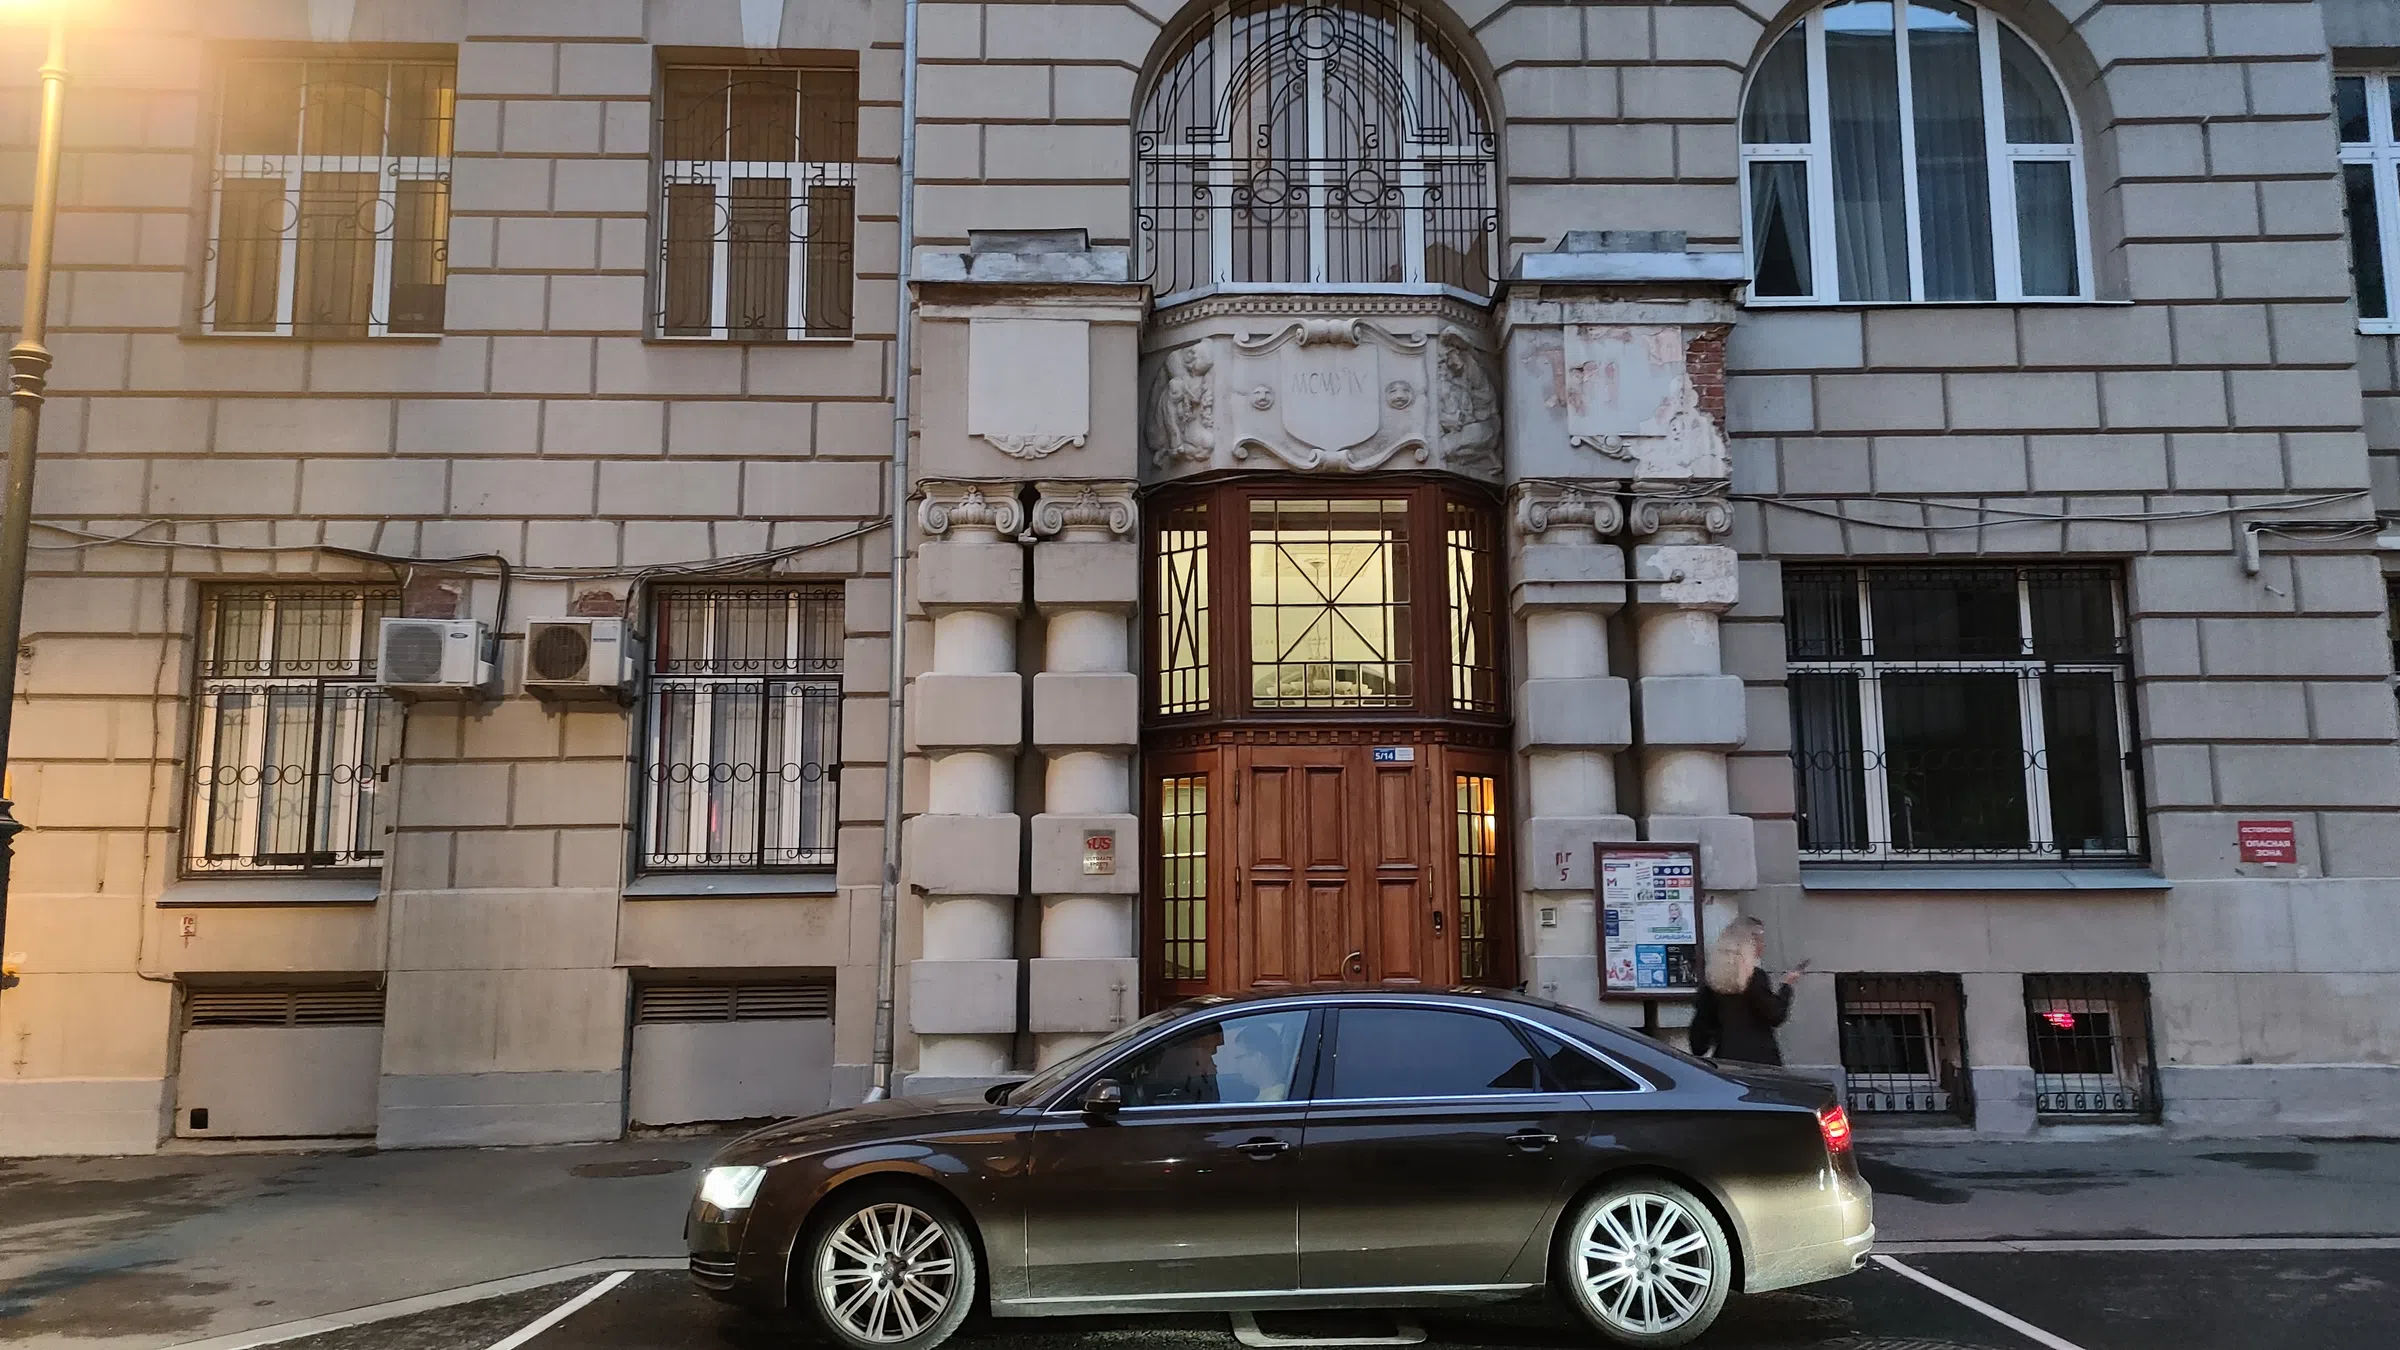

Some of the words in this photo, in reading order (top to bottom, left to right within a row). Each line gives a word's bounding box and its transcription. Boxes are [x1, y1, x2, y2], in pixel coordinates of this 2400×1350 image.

[1375, 752, 1394, 760] 5/14
[2246, 840, 2291, 848] ОПАСНАЯ
[2255, 849, 2283, 857] ЗОНА
